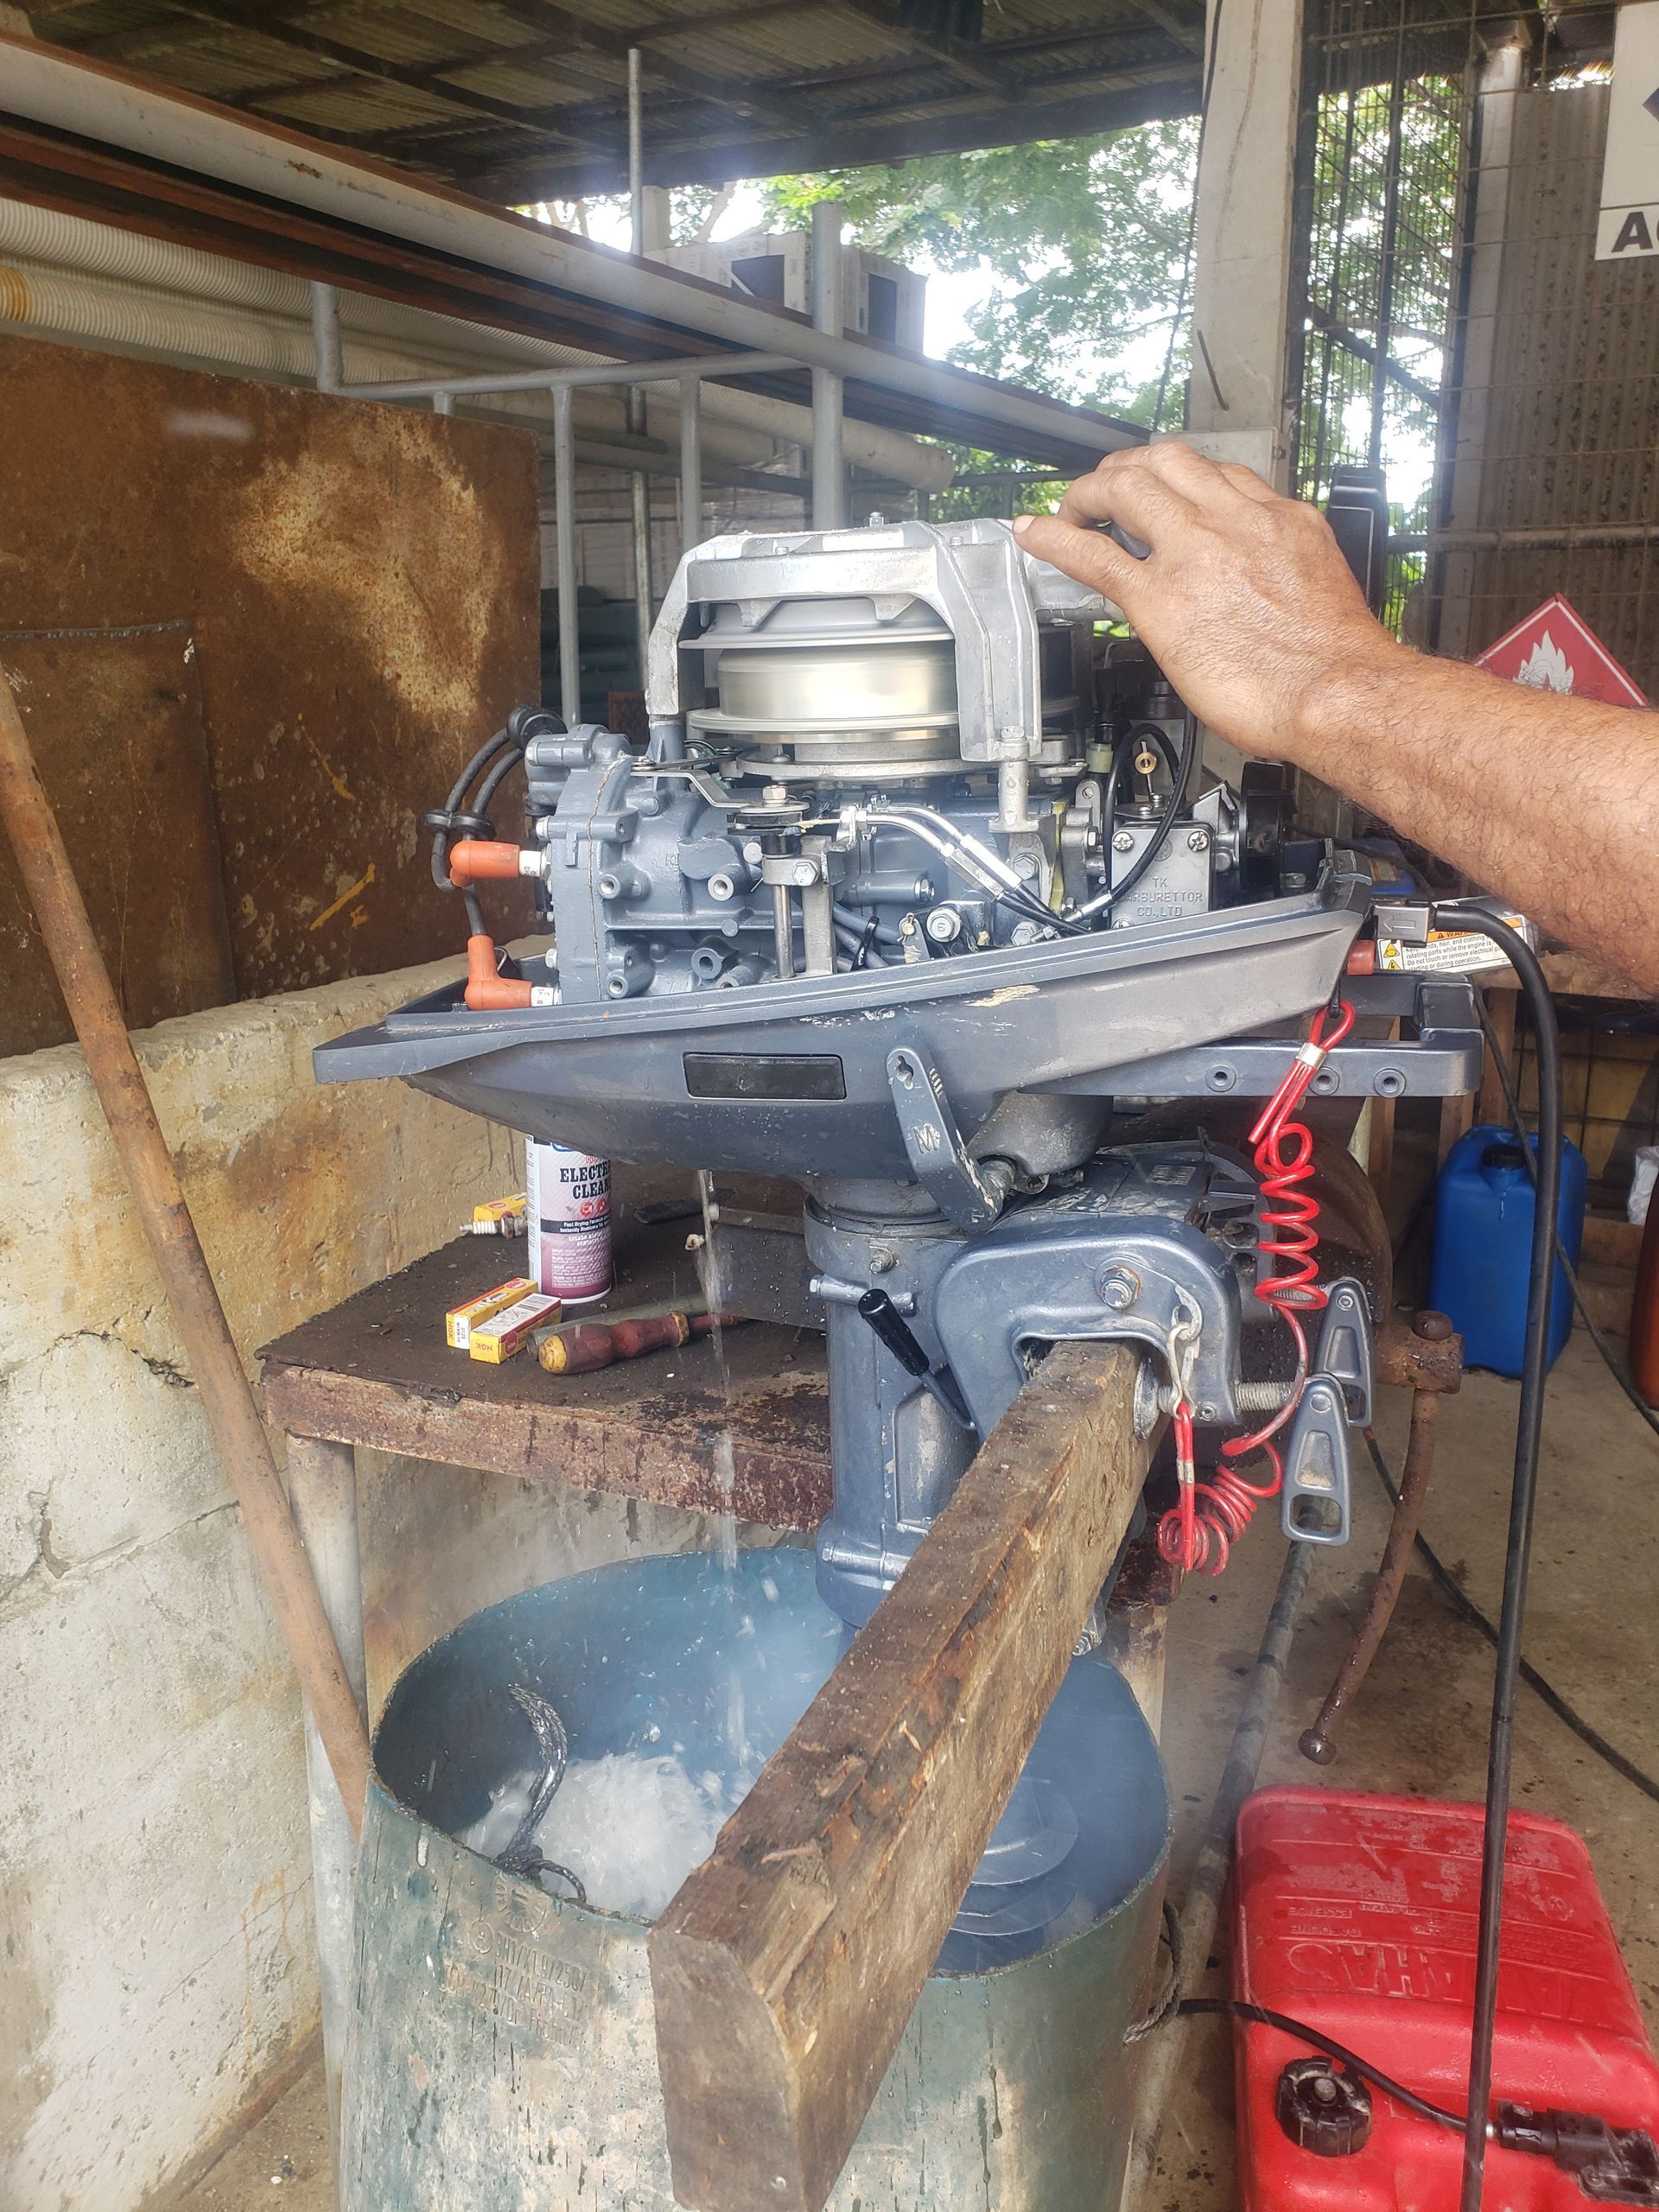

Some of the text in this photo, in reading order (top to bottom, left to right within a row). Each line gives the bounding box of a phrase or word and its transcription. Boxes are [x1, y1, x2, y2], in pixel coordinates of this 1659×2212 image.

[1611, 211, 1659, 253] A
[1152, 876, 1168, 887] TK
[1406, 951, 1427, 960] rotating
[1428, 949, 1442, 957] parts
[1467, 942, 1485, 950] engine
[1469, 946, 1494, 956] electrical
[559, 1160, 611, 1183] ELECTR
[475, 1341, 493, 1351] NGK
